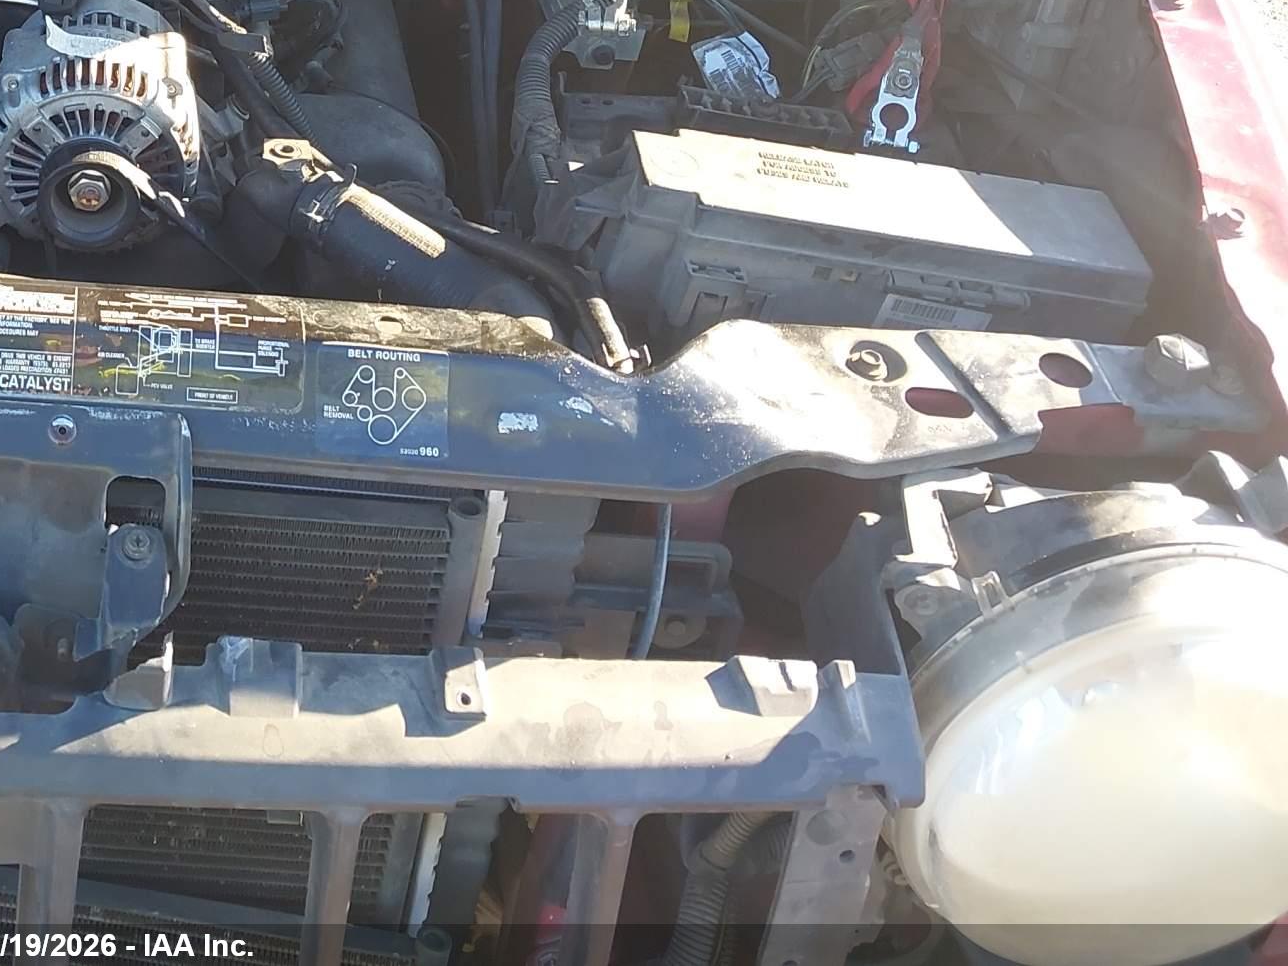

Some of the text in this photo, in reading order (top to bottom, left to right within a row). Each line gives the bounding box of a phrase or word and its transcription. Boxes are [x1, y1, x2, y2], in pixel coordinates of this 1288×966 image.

[348, 349, 420, 362] BELT ROUTING
[0, 374, 71, 392] CATALYST
[324, 412, 353, 420] REMOVAL
[420, 447, 439, 456] 960
